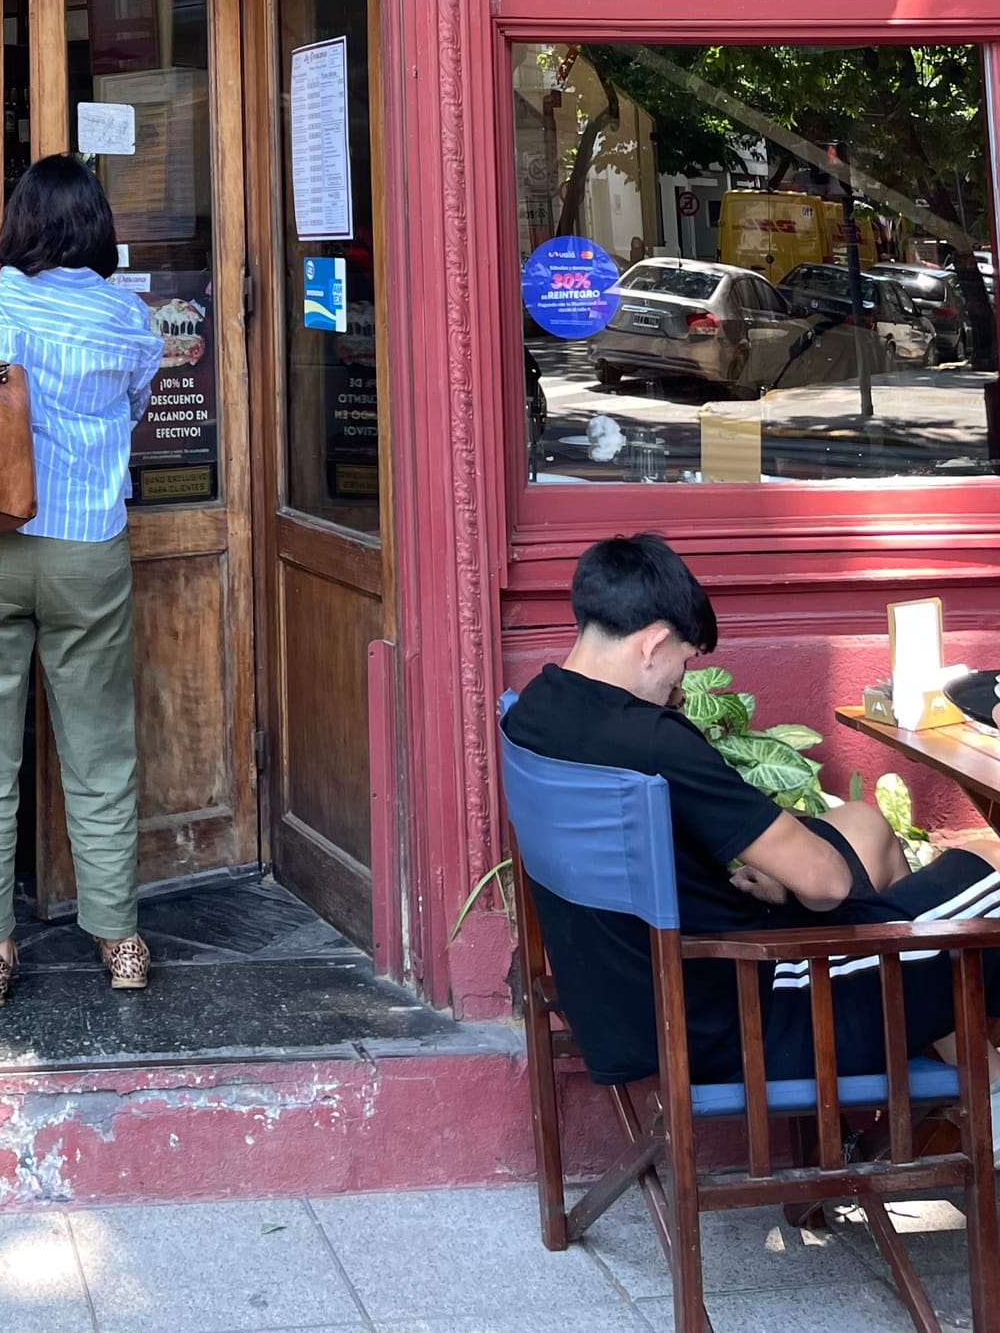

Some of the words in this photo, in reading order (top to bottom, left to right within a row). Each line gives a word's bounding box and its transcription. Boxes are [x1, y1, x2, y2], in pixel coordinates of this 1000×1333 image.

[551, 272, 591, 290] 30%
[548, 290, 600, 299] REINTEGRO
[160, 378, 181, 391] ¡10%
[182, 377, 194, 388] DE
[150, 393, 205, 406] DESCUENTO
[147, 410, 194, 422] PAGANDO
[196, 410, 208, 420] EN
[156, 427, 201, 438] EFECTIVO!
